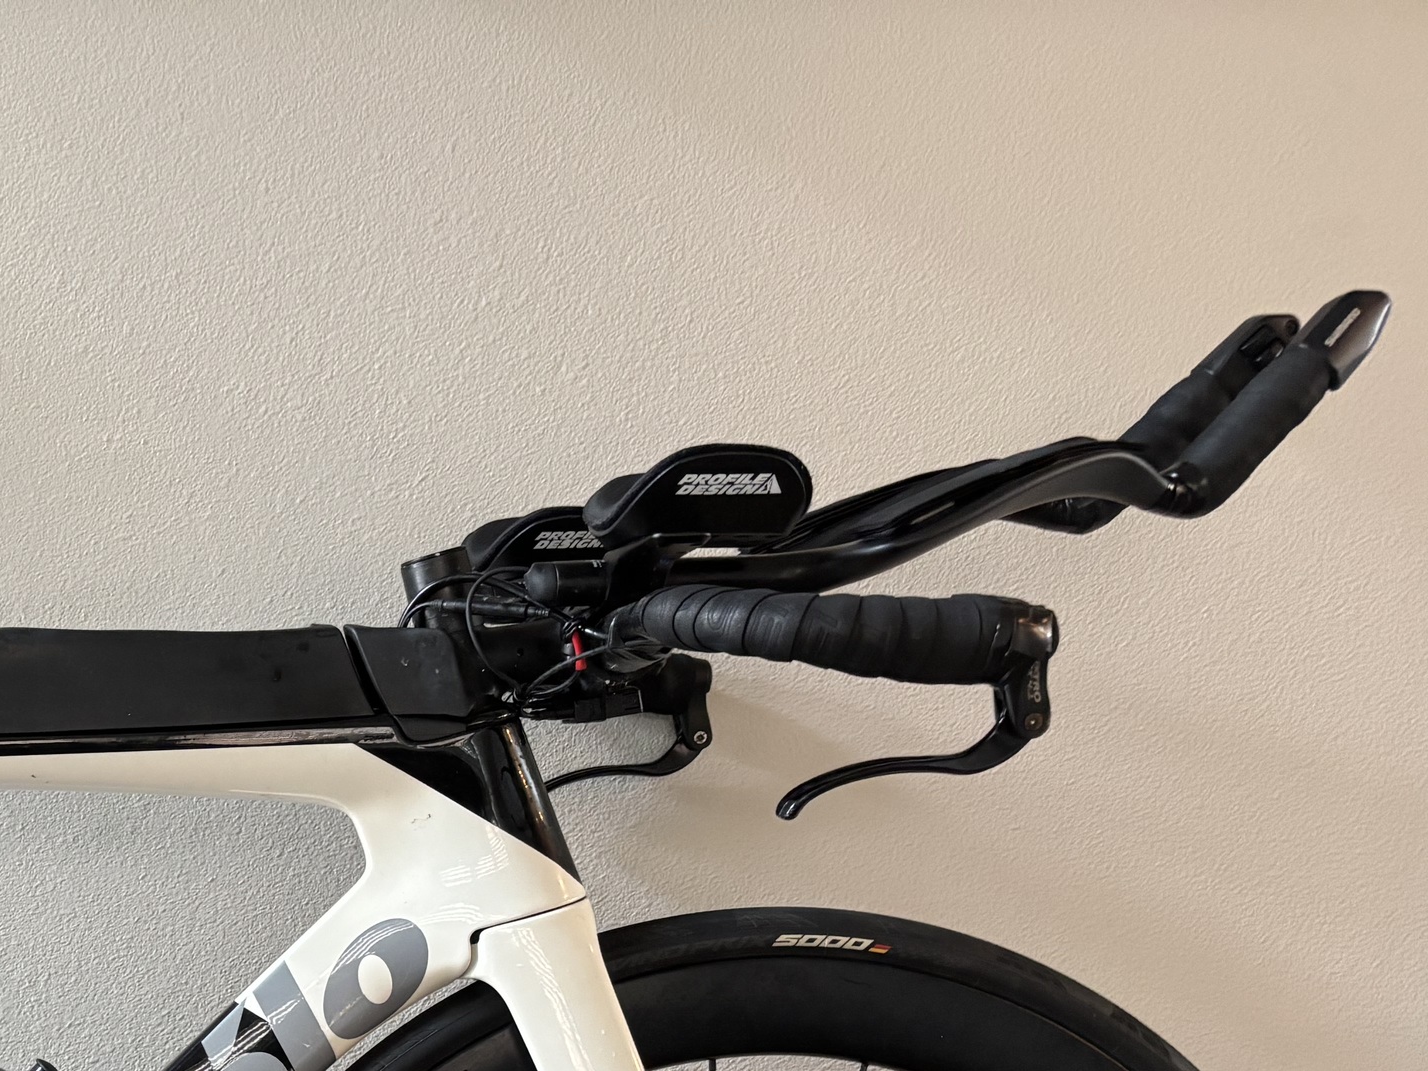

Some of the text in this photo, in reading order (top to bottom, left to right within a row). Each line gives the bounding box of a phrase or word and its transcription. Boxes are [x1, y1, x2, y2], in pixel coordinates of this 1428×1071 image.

[677, 473, 773, 485] PROFILE
[675, 484, 764, 496] DESIGN
[534, 530, 597, 541] PROFIL
[772, 934, 875, 951] 5000
